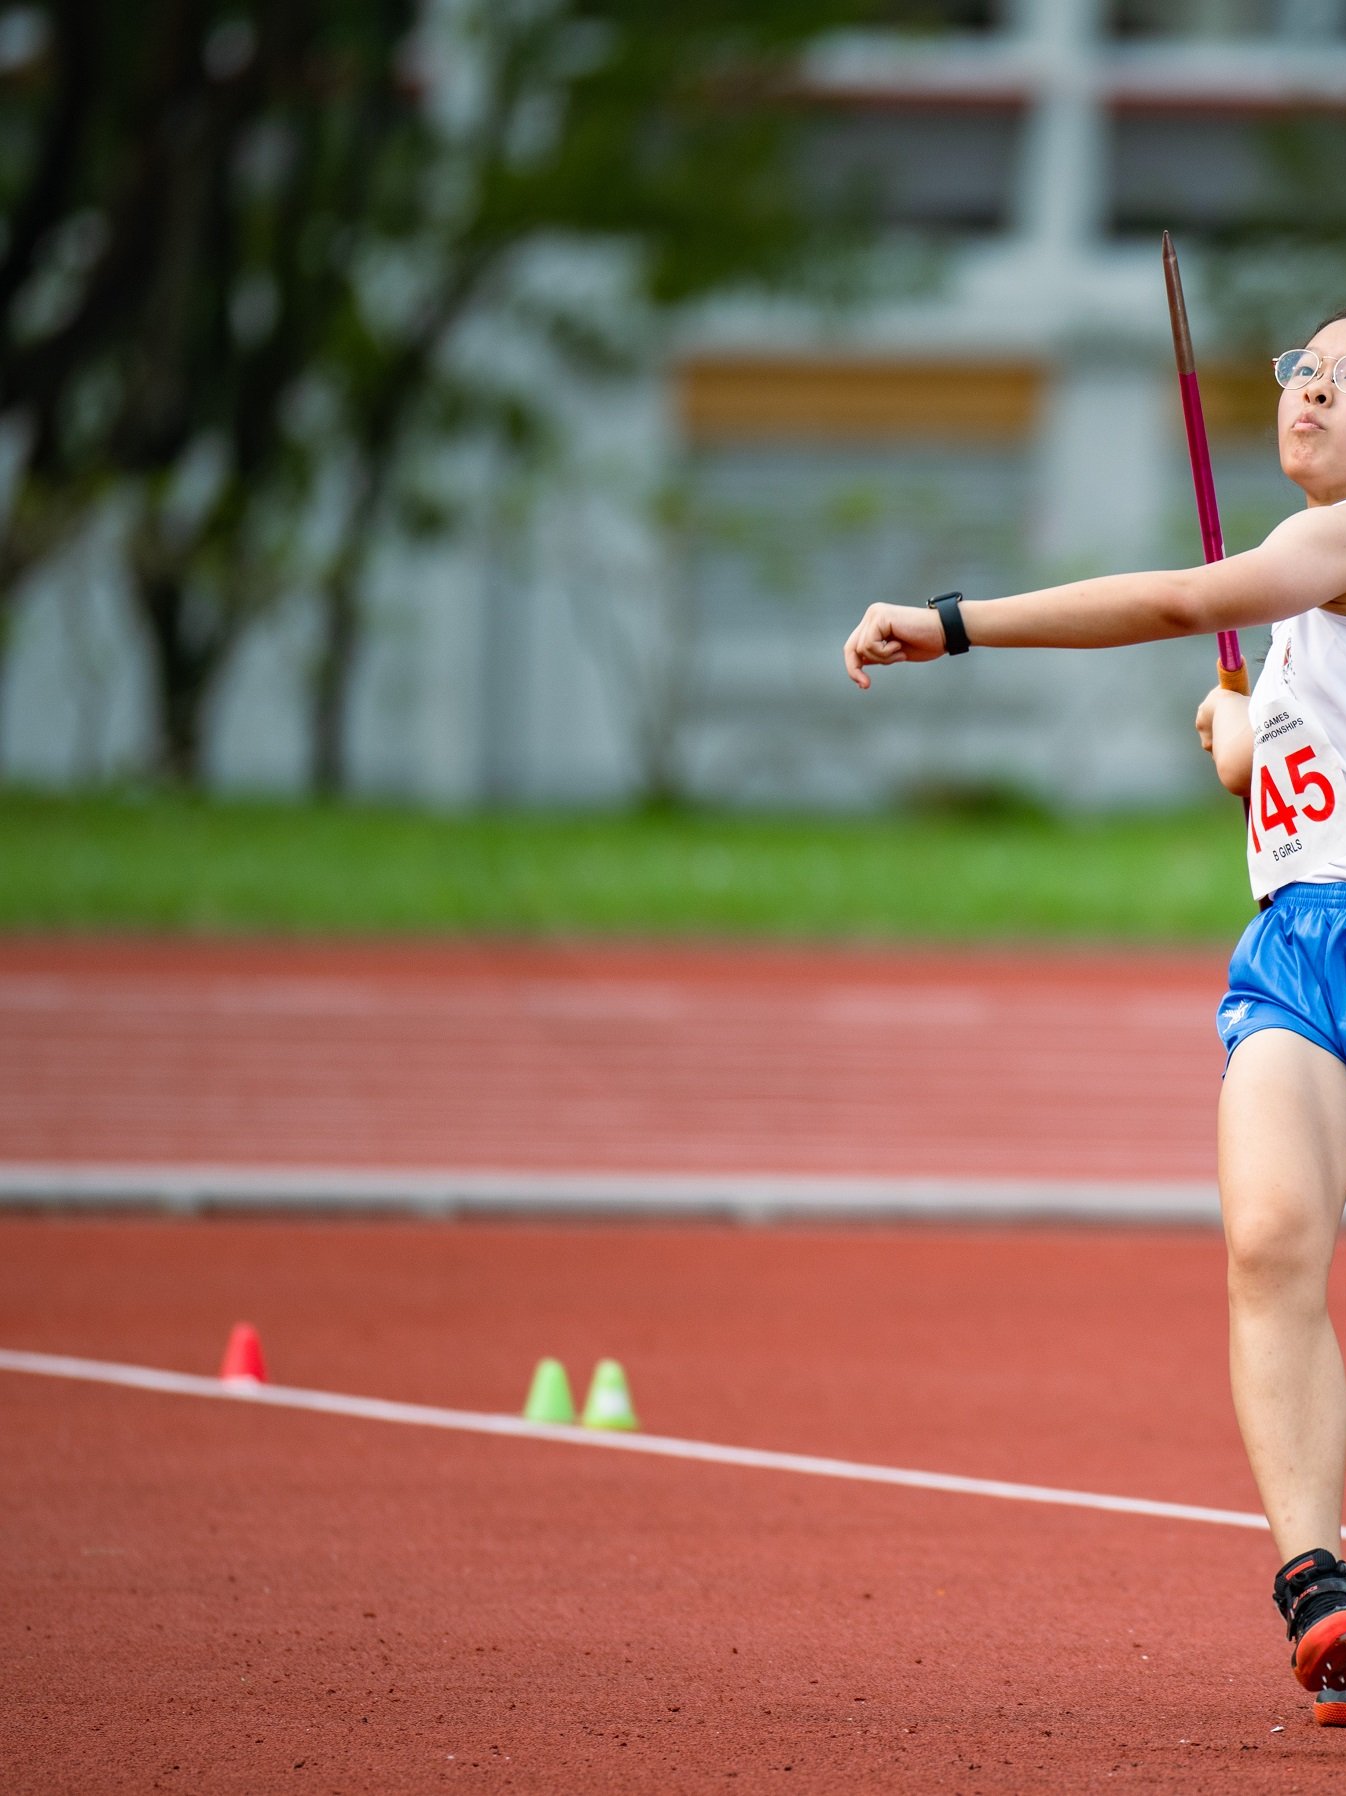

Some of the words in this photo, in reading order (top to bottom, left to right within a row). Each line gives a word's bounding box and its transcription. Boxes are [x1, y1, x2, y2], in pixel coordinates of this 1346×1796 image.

[1256, 717, 1304, 744] MPIONSHIPS
[1264, 711, 1290, 729] GAMES
[1272, 850, 1280, 861] B
[1279, 839, 1303, 858] GIRLS
